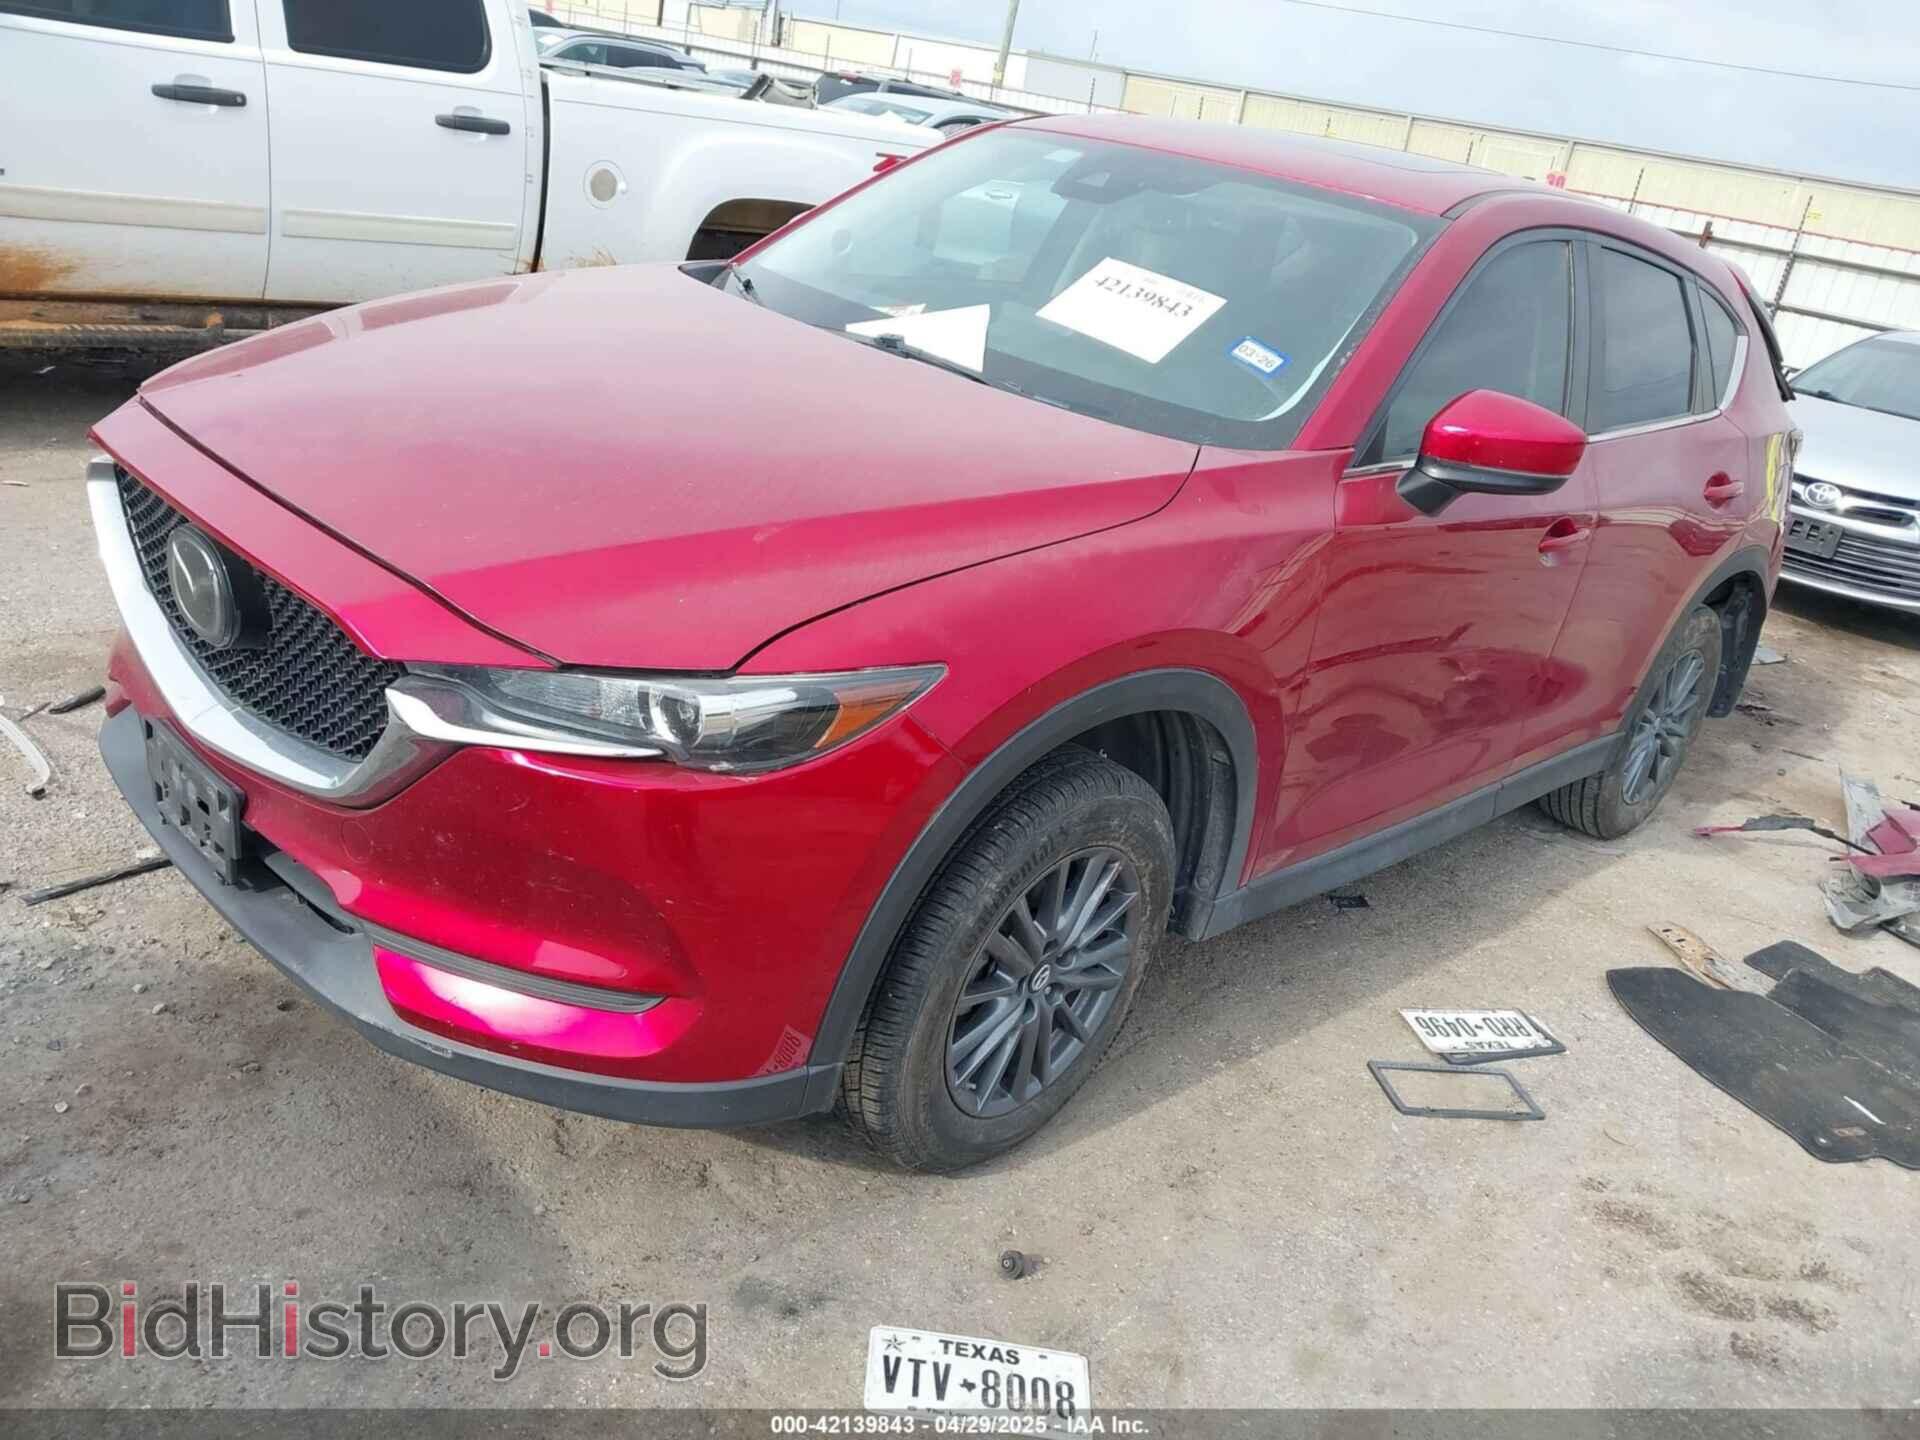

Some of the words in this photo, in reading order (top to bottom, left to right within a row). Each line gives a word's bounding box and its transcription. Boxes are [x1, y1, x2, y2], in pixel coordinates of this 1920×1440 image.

[1094, 276, 1194, 318] 42139843
[1238, 344, 1276, 369] 03-26
[938, 1339, 1020, 1365] TEXAS
[883, 1355, 951, 1401] VTV
[981, 1369, 1075, 1420] 8008
